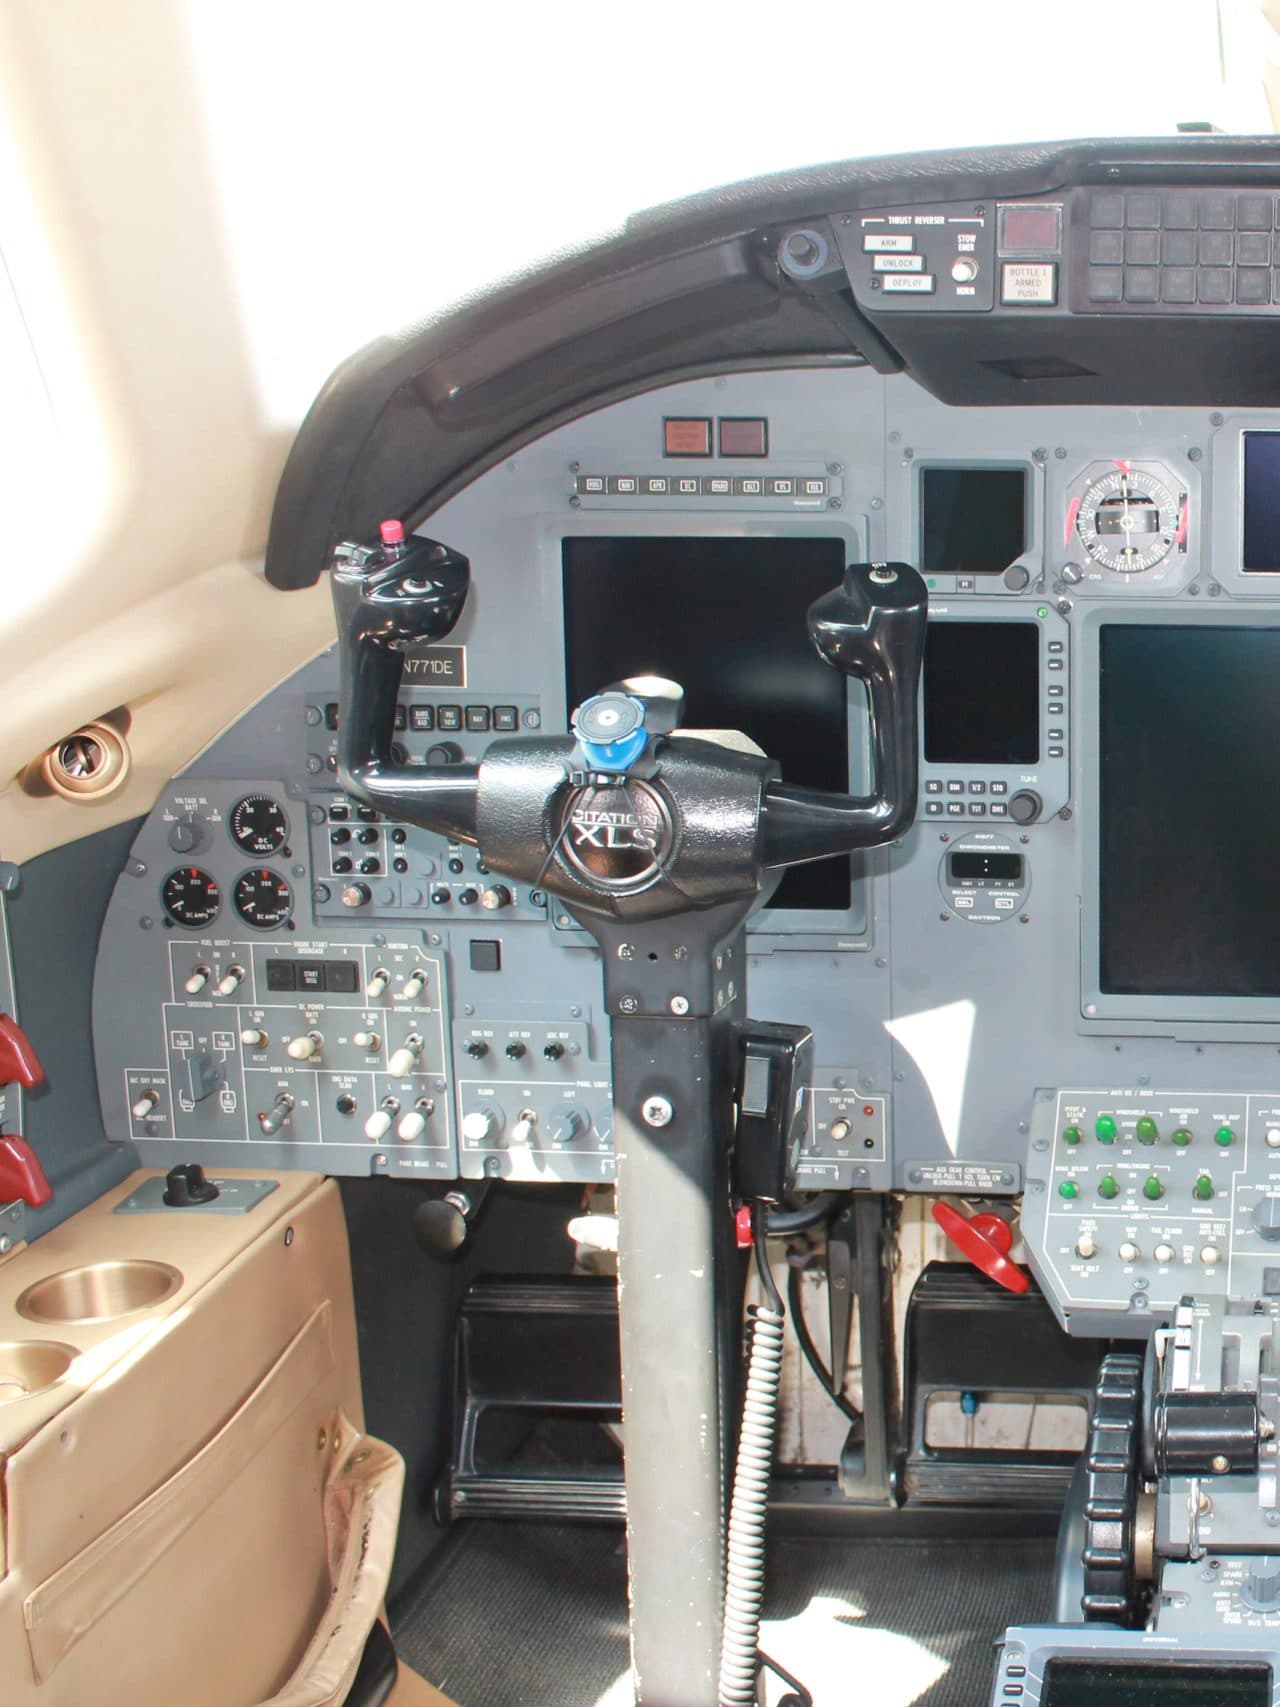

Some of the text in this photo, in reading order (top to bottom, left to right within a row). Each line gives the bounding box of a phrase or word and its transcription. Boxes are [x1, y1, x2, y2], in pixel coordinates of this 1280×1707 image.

[888, 216, 945, 225] THRUST REVERSER
[881, 239, 897, 247] ARM
[883, 259, 913, 267] UNLOCK
[1009, 268, 1039, 276] BOTTLE
[893, 279, 922, 287] DEPLOY
[1018, 289, 1038, 297] PUSH
[404, 660, 453, 675] N771DE
[174, 797, 197, 805] VOLTAGE
[573, 824, 657, 849] XLS
